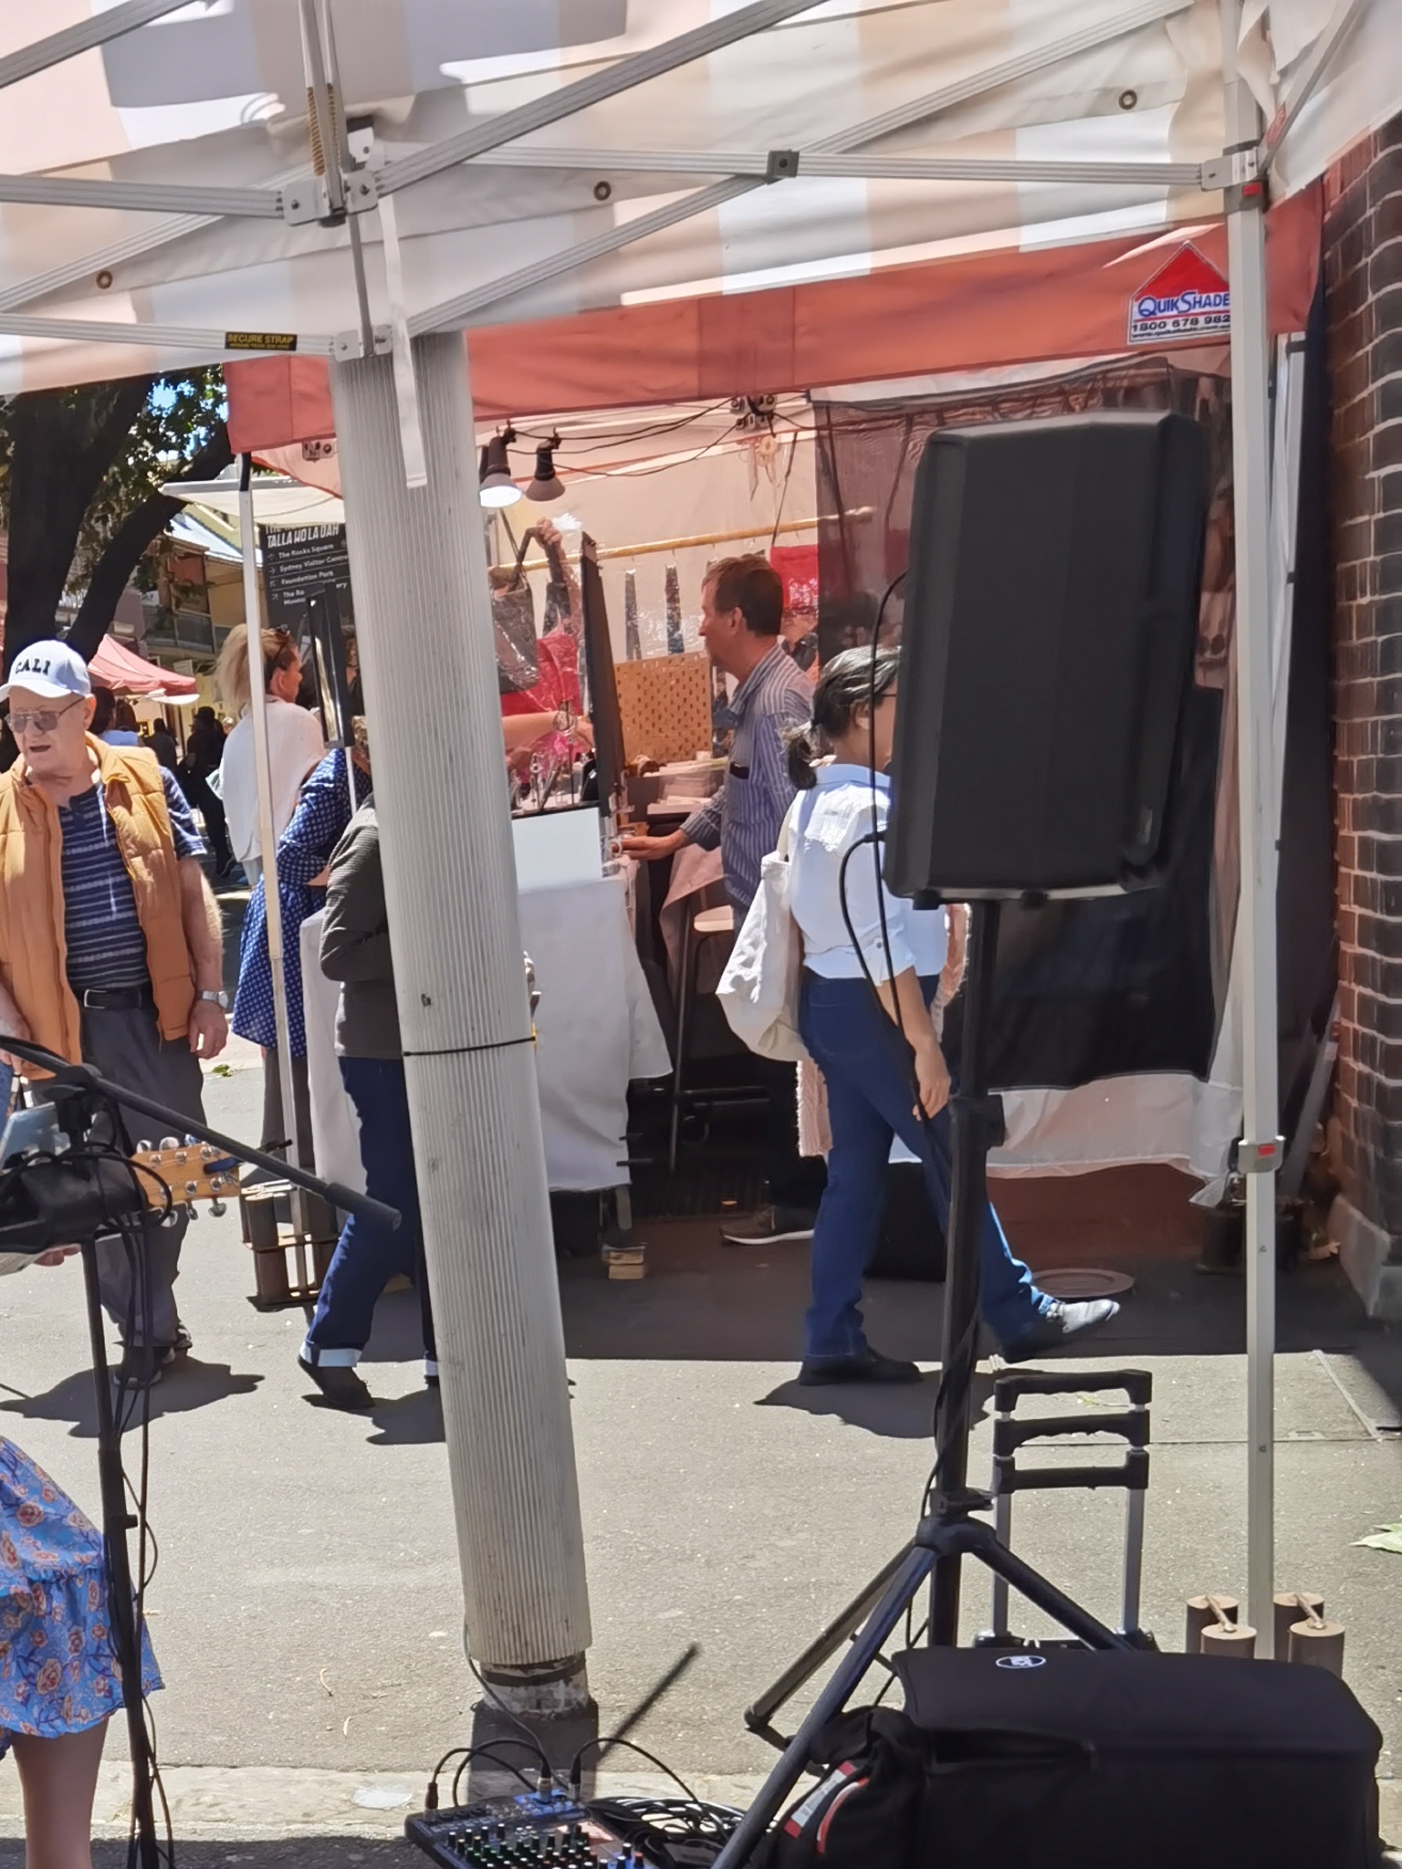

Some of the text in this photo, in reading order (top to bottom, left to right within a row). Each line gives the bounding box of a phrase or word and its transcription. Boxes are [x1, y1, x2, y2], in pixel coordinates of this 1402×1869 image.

[1132, 321, 1166, 332] 1800
[1172, 317, 1199, 328] 678
[227, 333, 294, 344] SECURE STRAP
[291, 548, 310, 556] Rocks
[311, 544, 334, 553] Square
[280, 563, 302, 572] Sydney
[304, 560, 325, 568] Visitor
[281, 575, 318, 585] Foundation
[15, 658, 51, 676] CALI
